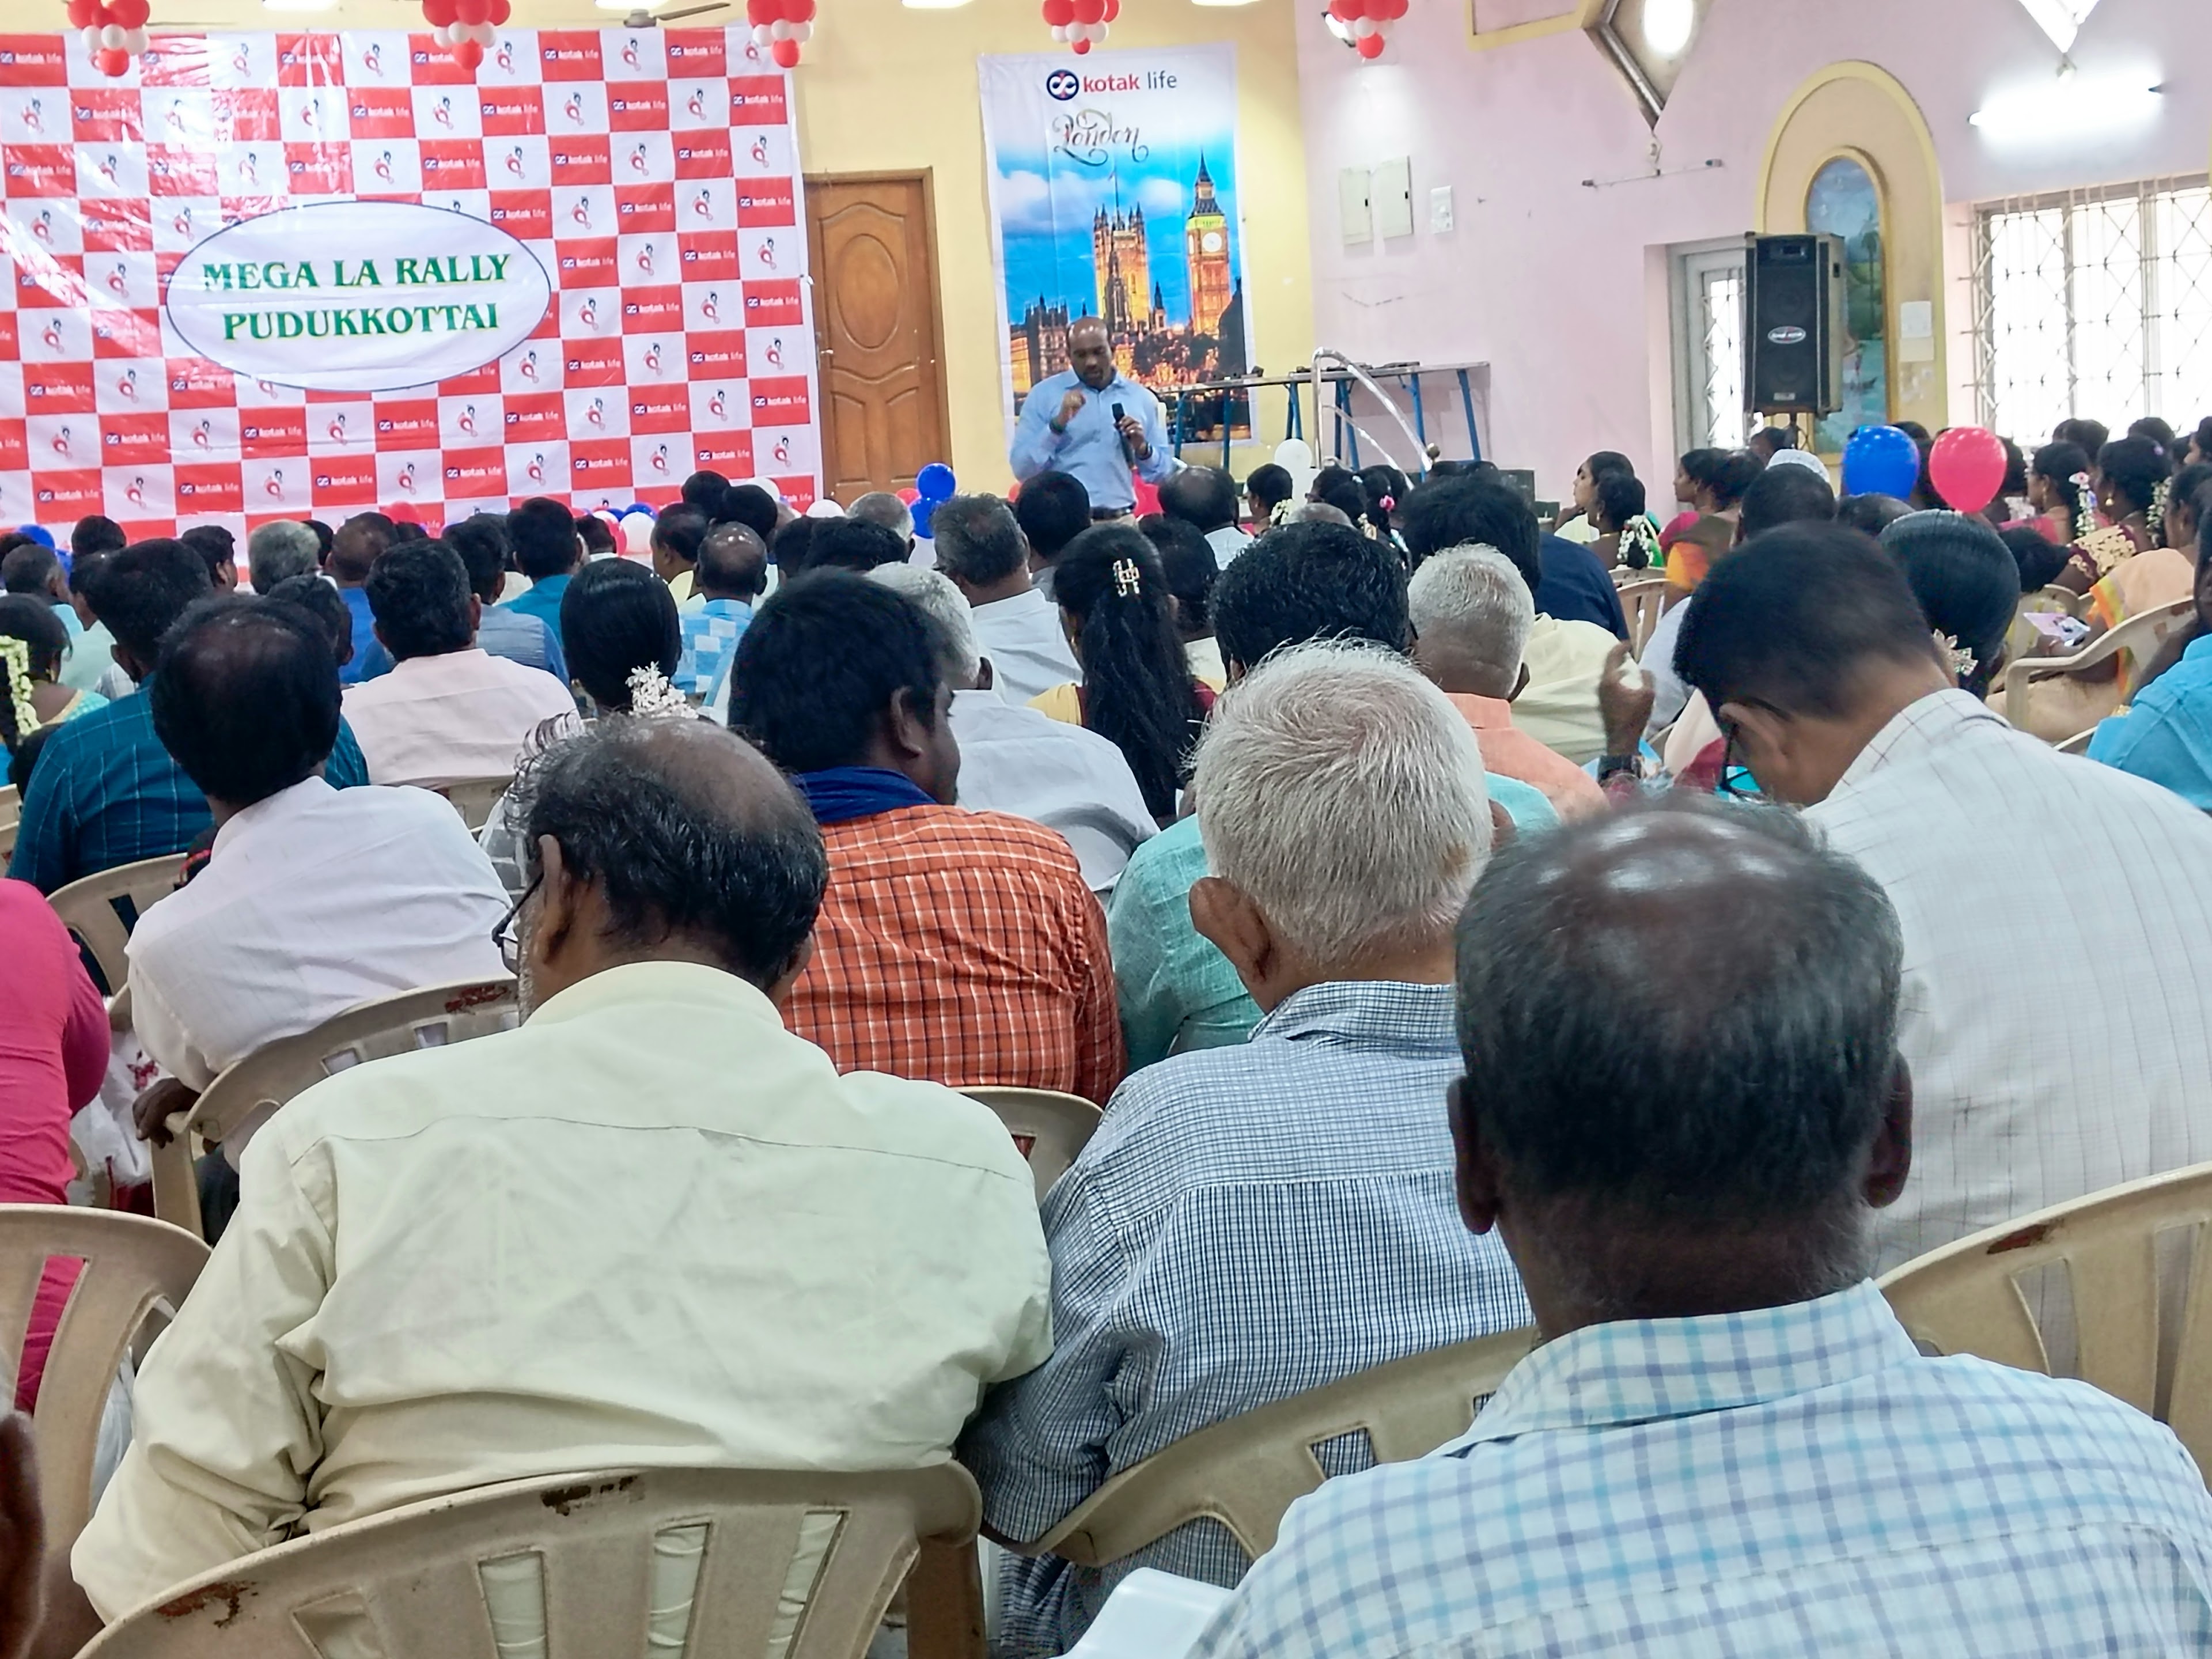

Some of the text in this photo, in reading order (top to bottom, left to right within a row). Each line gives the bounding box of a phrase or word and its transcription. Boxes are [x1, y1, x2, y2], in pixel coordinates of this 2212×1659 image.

[1083, 71, 1177, 93] kotak life
[1052, 108, 1149, 166] London
[203, 253, 511, 290] MEGA LA RALLY
[223, 303, 499, 340] PUDUKKOTTAI
